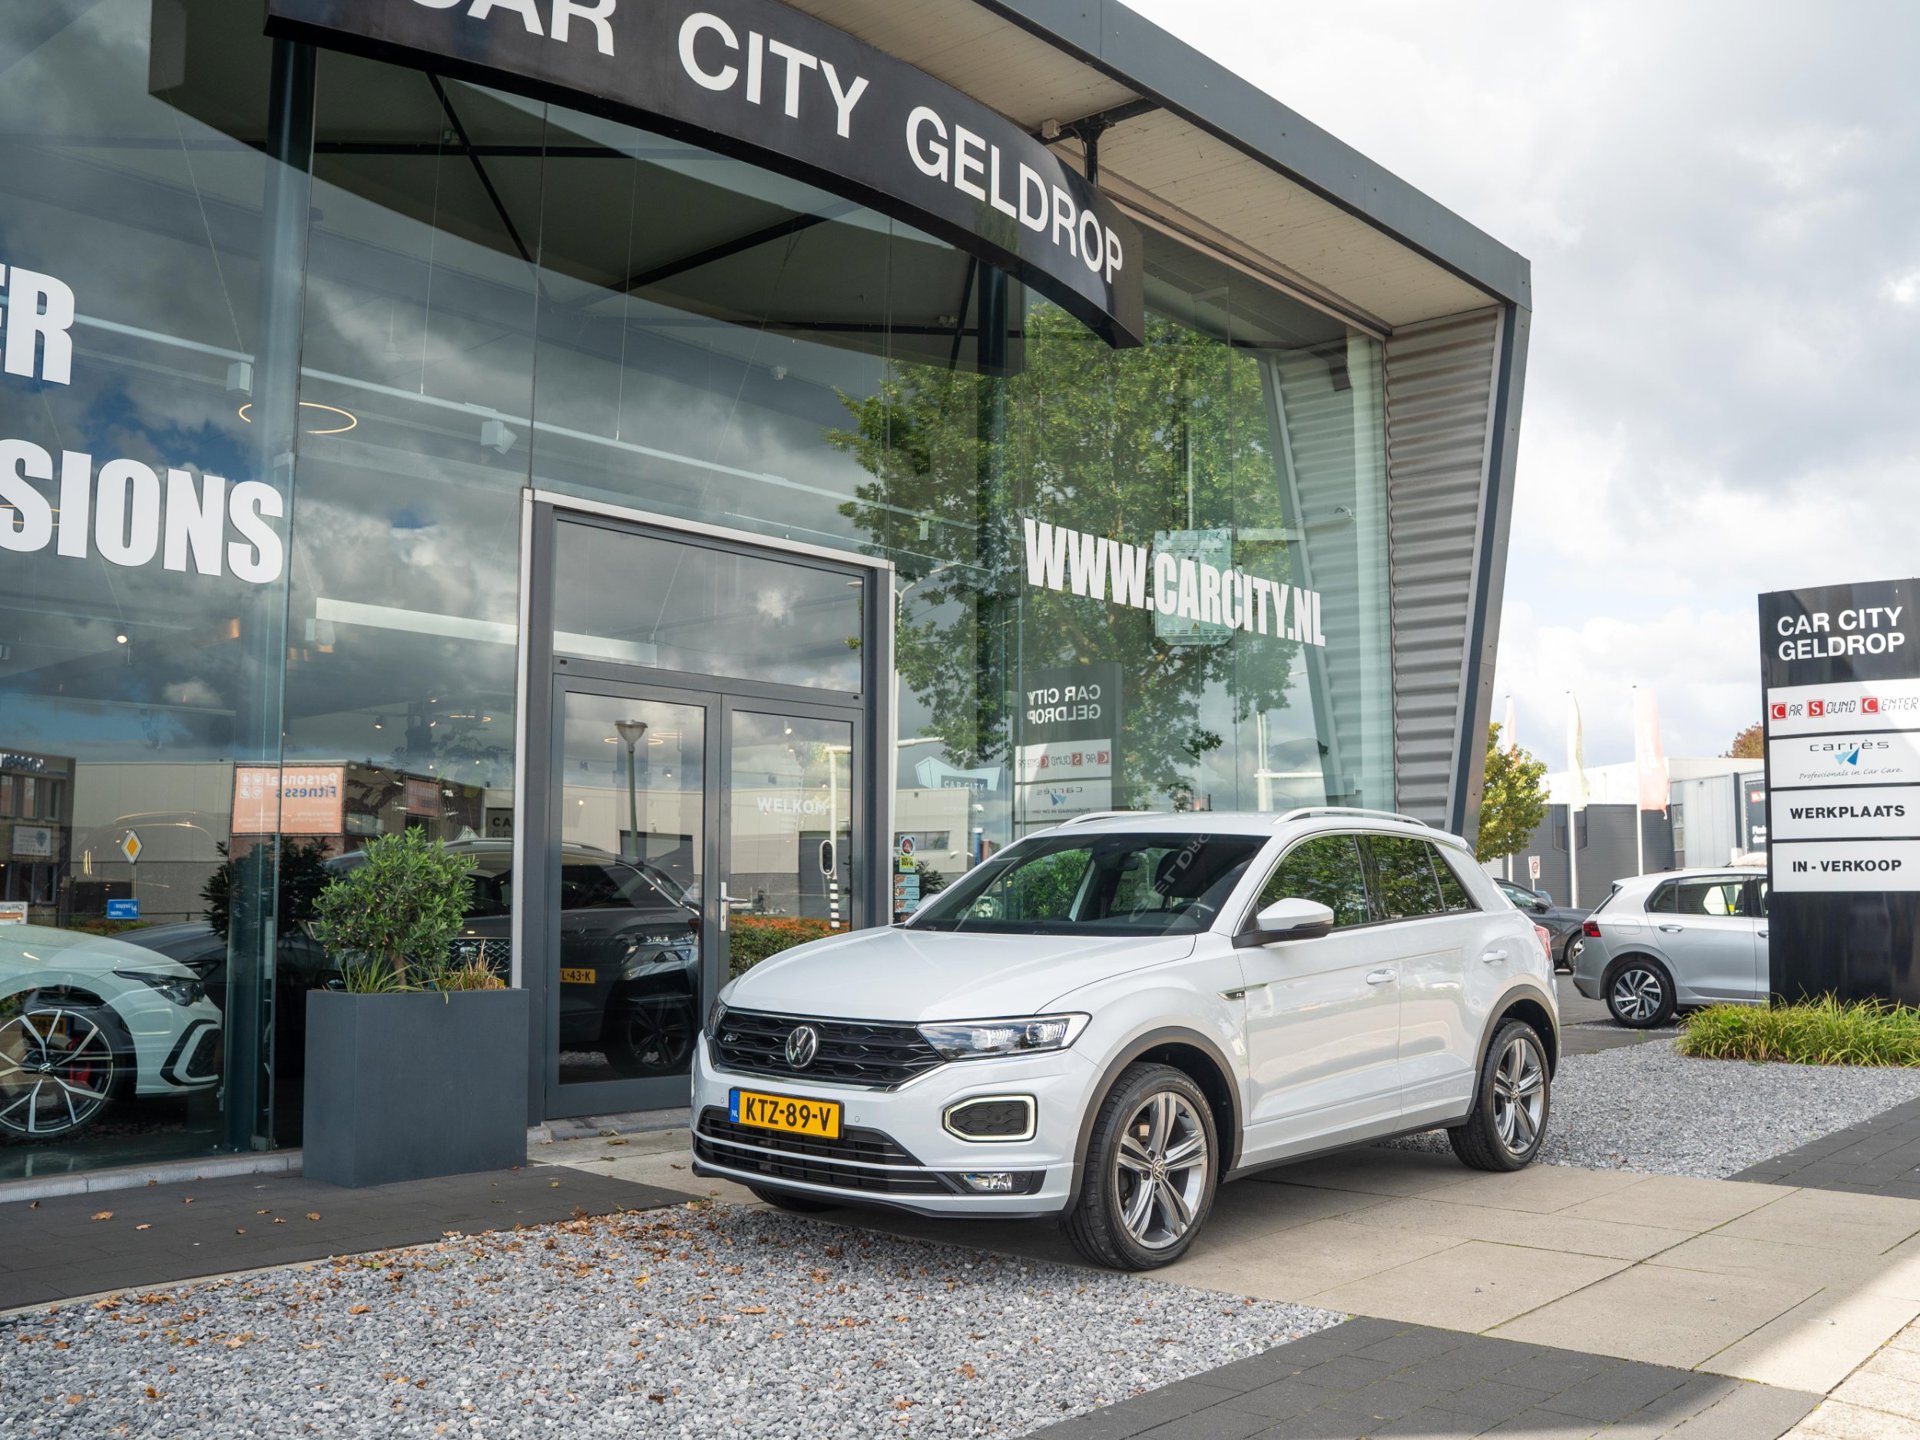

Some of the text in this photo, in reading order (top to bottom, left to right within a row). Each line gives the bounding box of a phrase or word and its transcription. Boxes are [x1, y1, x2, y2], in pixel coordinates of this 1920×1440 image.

[678, 12, 869, 139] CITY
[906, 106, 1123, 284] GELDROP
[0, 264, 75, 385] R
[1024, 518, 1326, 647] WWW.CARCITY.NL
[1777, 606, 1903, 636] CAR CITY
[1778, 632, 1905, 661] GELDROP
[1771, 703, 1804, 719] CAR
[1808, 700, 1856, 717] SOUND
[1809, 739, 1889, 752] carrès
[756, 797, 827, 816] WELKOM
[1790, 805, 1905, 819] WERKPLAATS
[745, 1096, 832, 1132] KTZ-89-V
